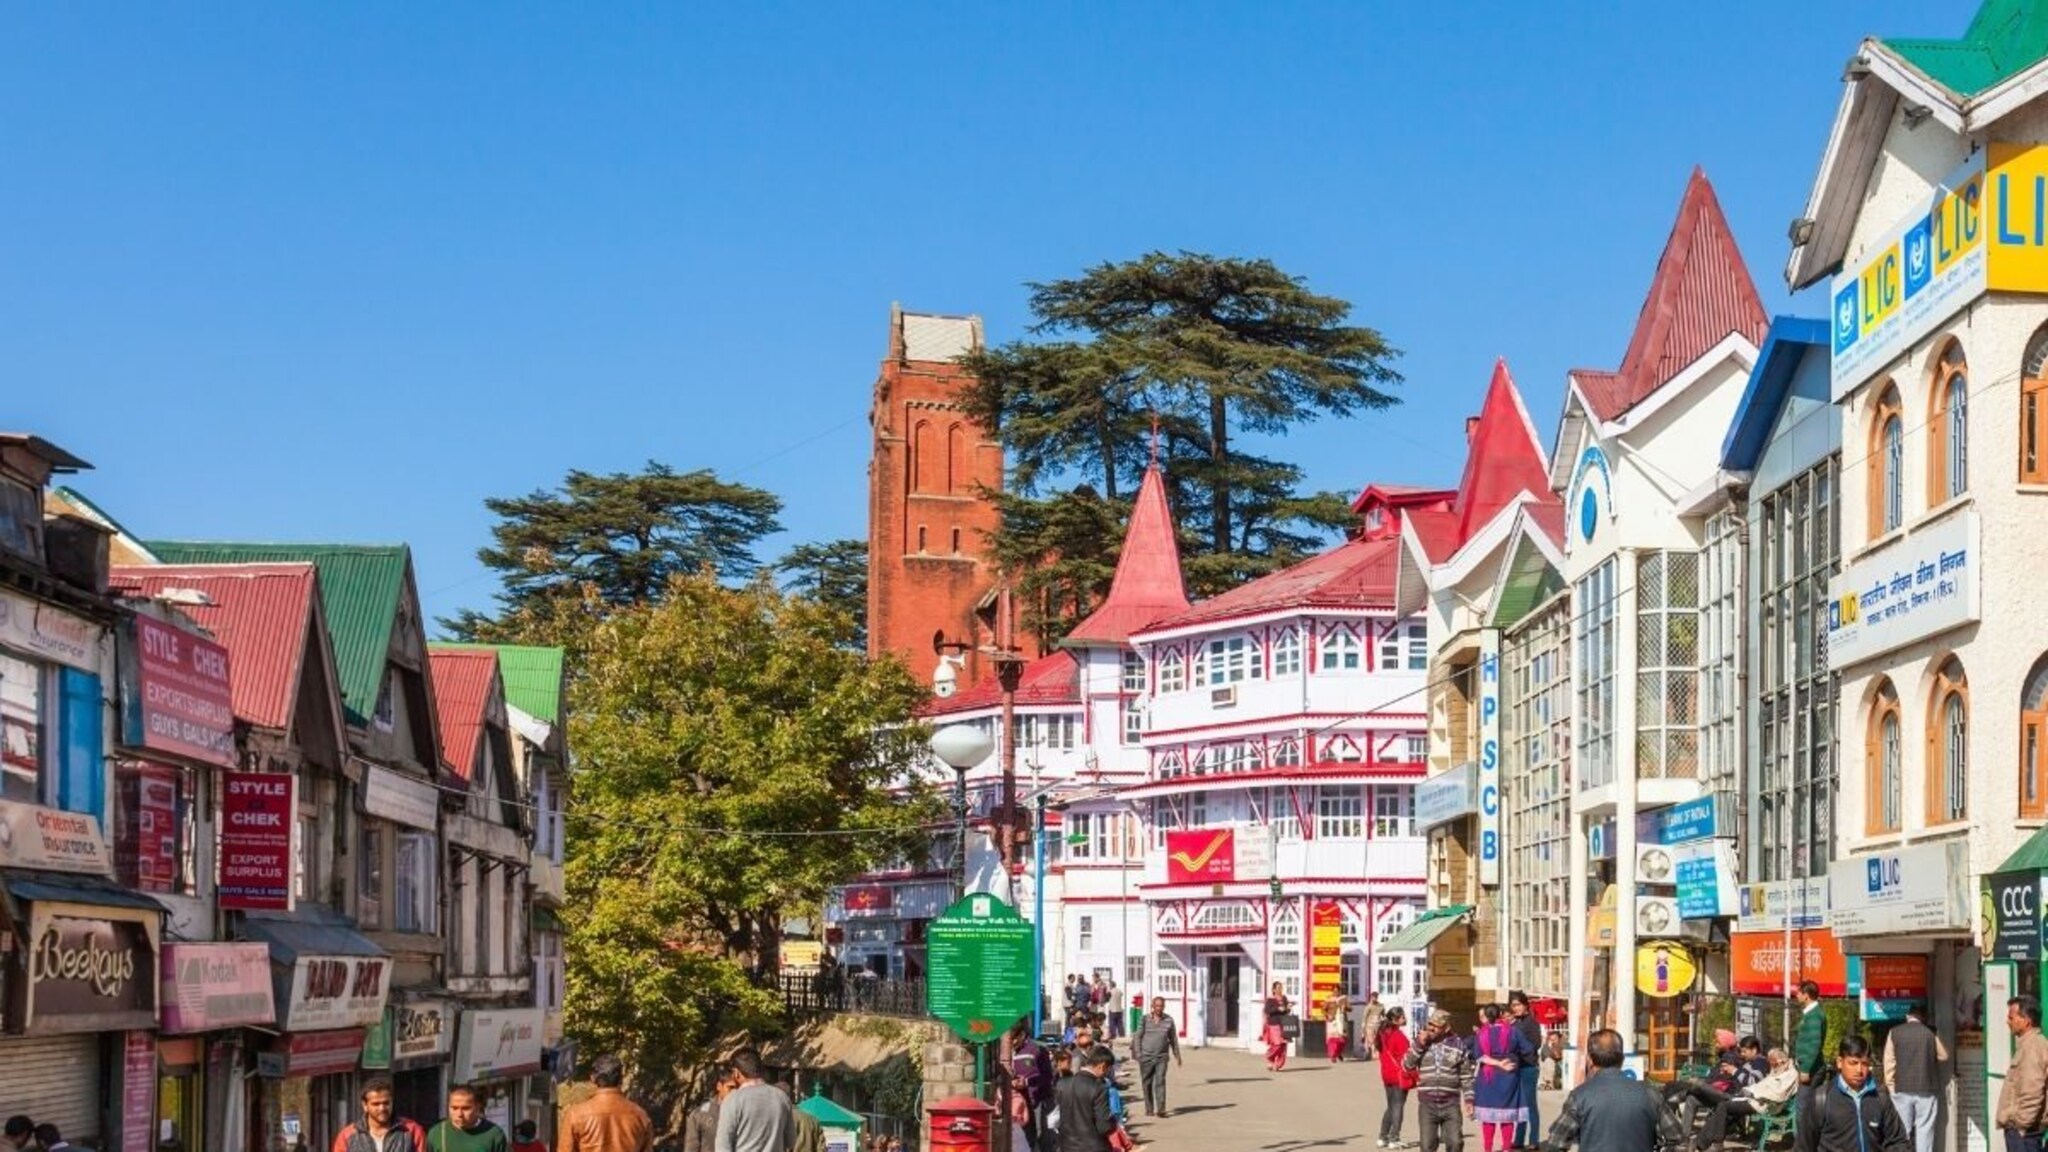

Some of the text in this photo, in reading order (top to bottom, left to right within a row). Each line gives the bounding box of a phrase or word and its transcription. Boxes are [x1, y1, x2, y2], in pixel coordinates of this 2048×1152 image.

[1937, 182, 1979, 264] LIC
[1864, 254, 1895, 324] LIC
[144, 625, 178, 663] STYLE
[192, 645, 228, 682] CHEK
[152, 713, 179, 738] GUYS
[1482, 653, 1497, 859] HPSCB
[230, 782, 285, 796] STYLE
[36, 811, 90, 836] Oriental
[231, 812, 281, 826] CHEK
[226, 866, 283, 878] SURPLUS
[231, 854, 279, 866] EXPORT
[1883, 858, 1901, 886] LIC
[2002, 885, 2034, 918] CCC
[33, 926, 134, 998] Beekays
[201, 957, 239, 983] Kodak
